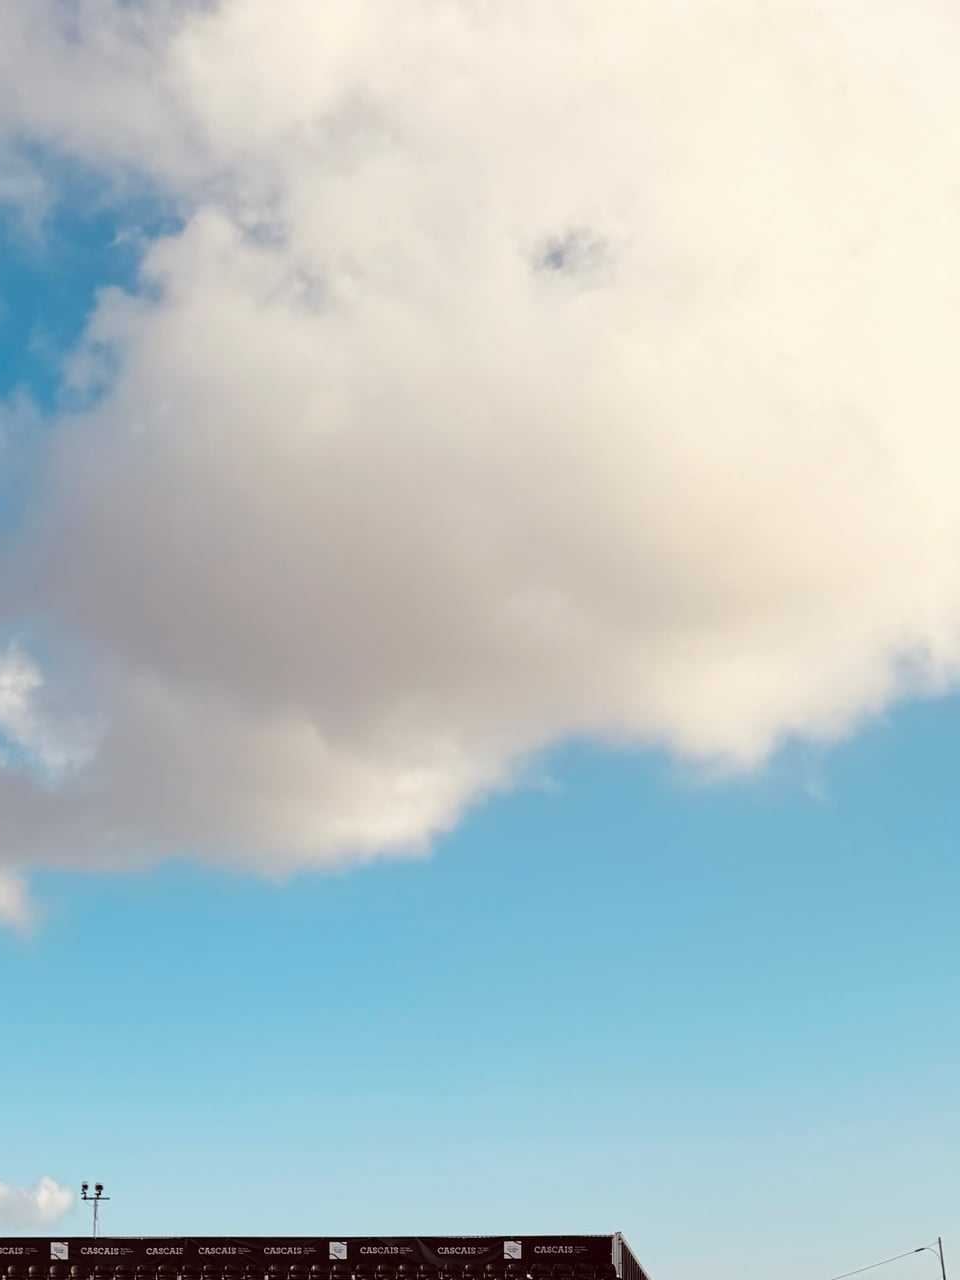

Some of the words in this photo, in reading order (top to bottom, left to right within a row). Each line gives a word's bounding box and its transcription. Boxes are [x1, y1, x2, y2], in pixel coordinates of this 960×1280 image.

[80, 1247, 119, 1255] CASCAIS
[198, 1247, 236, 1255] CASCAIS
[263, 1247, 302, 1255] CASCAIS
[360, 1246, 399, 1254] CASCAIS
[437, 1246, 476, 1255] CASCAIS
[534, 1245, 573, 1254] CASCAIS
